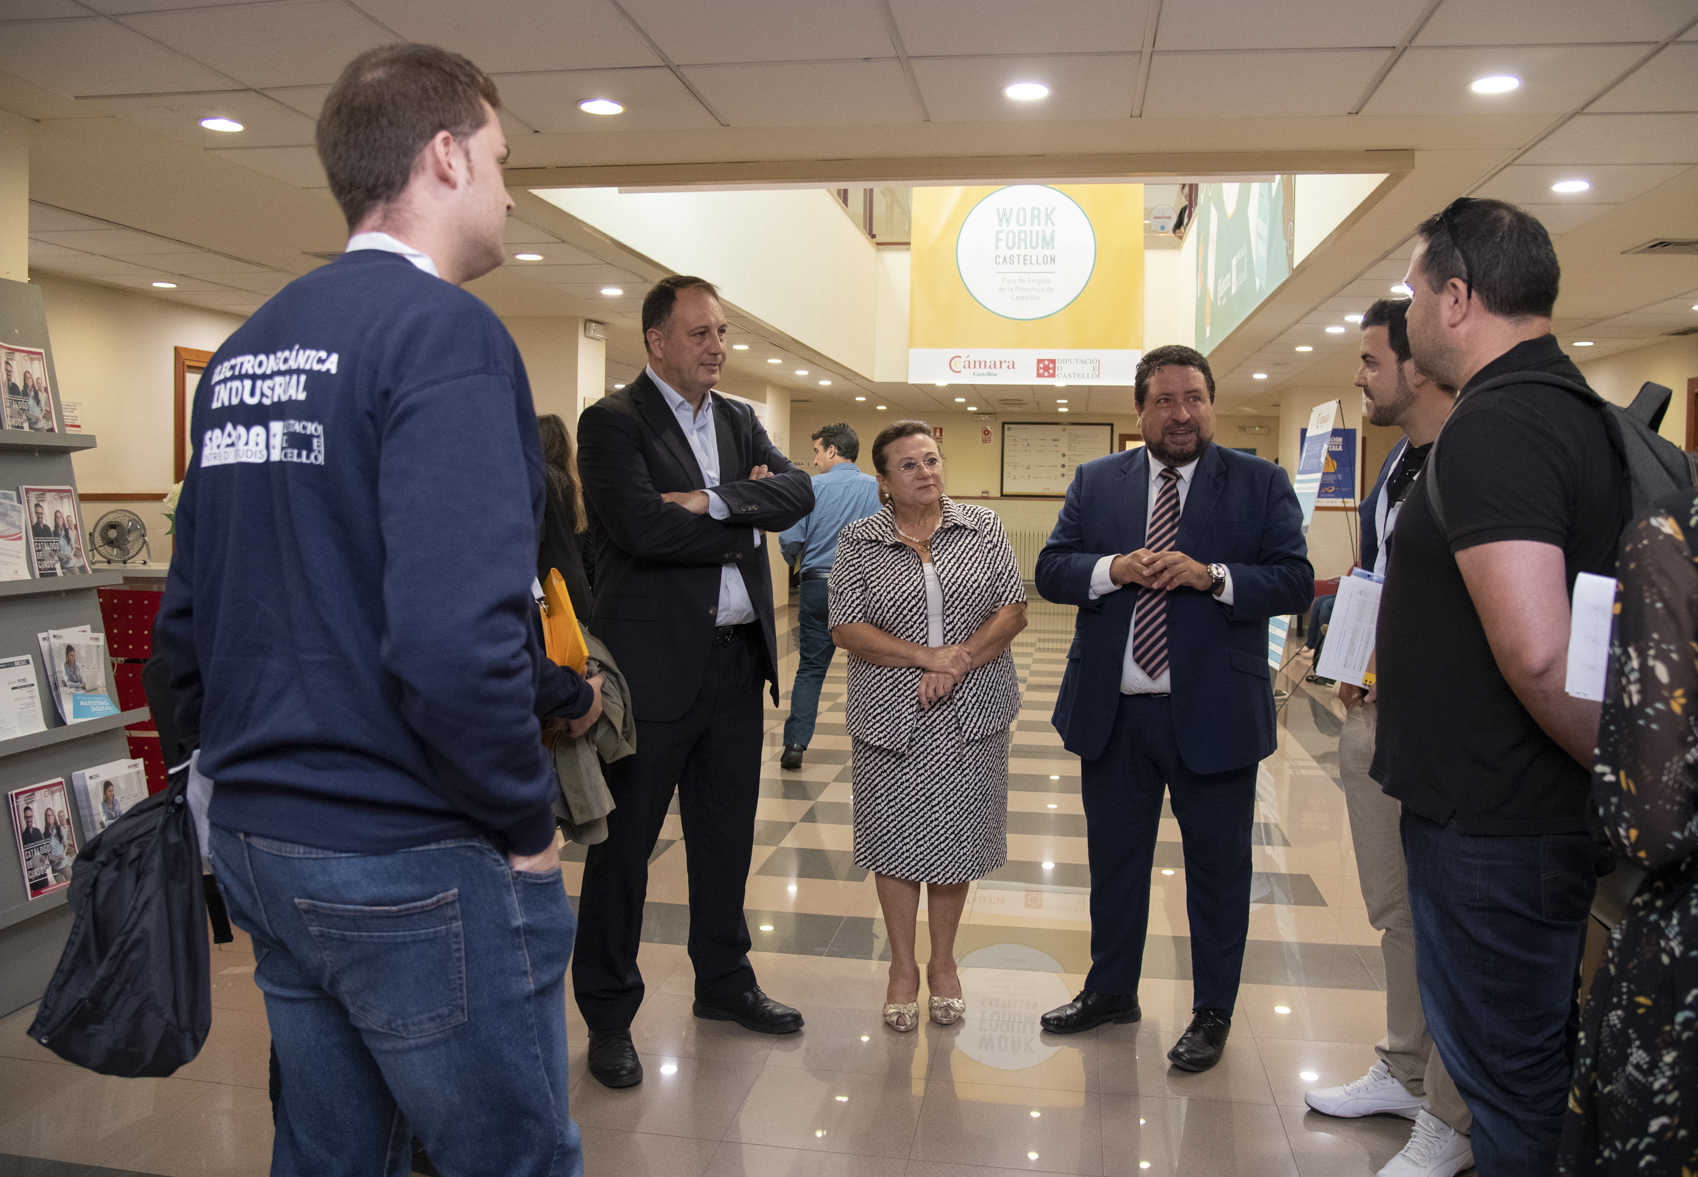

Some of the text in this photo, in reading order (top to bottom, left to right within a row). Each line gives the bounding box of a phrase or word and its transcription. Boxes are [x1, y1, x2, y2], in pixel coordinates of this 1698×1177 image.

[995, 206, 1057, 227] WORK
[994, 229, 1056, 250] FORUM
[948, 355, 1016, 374] Cámara
